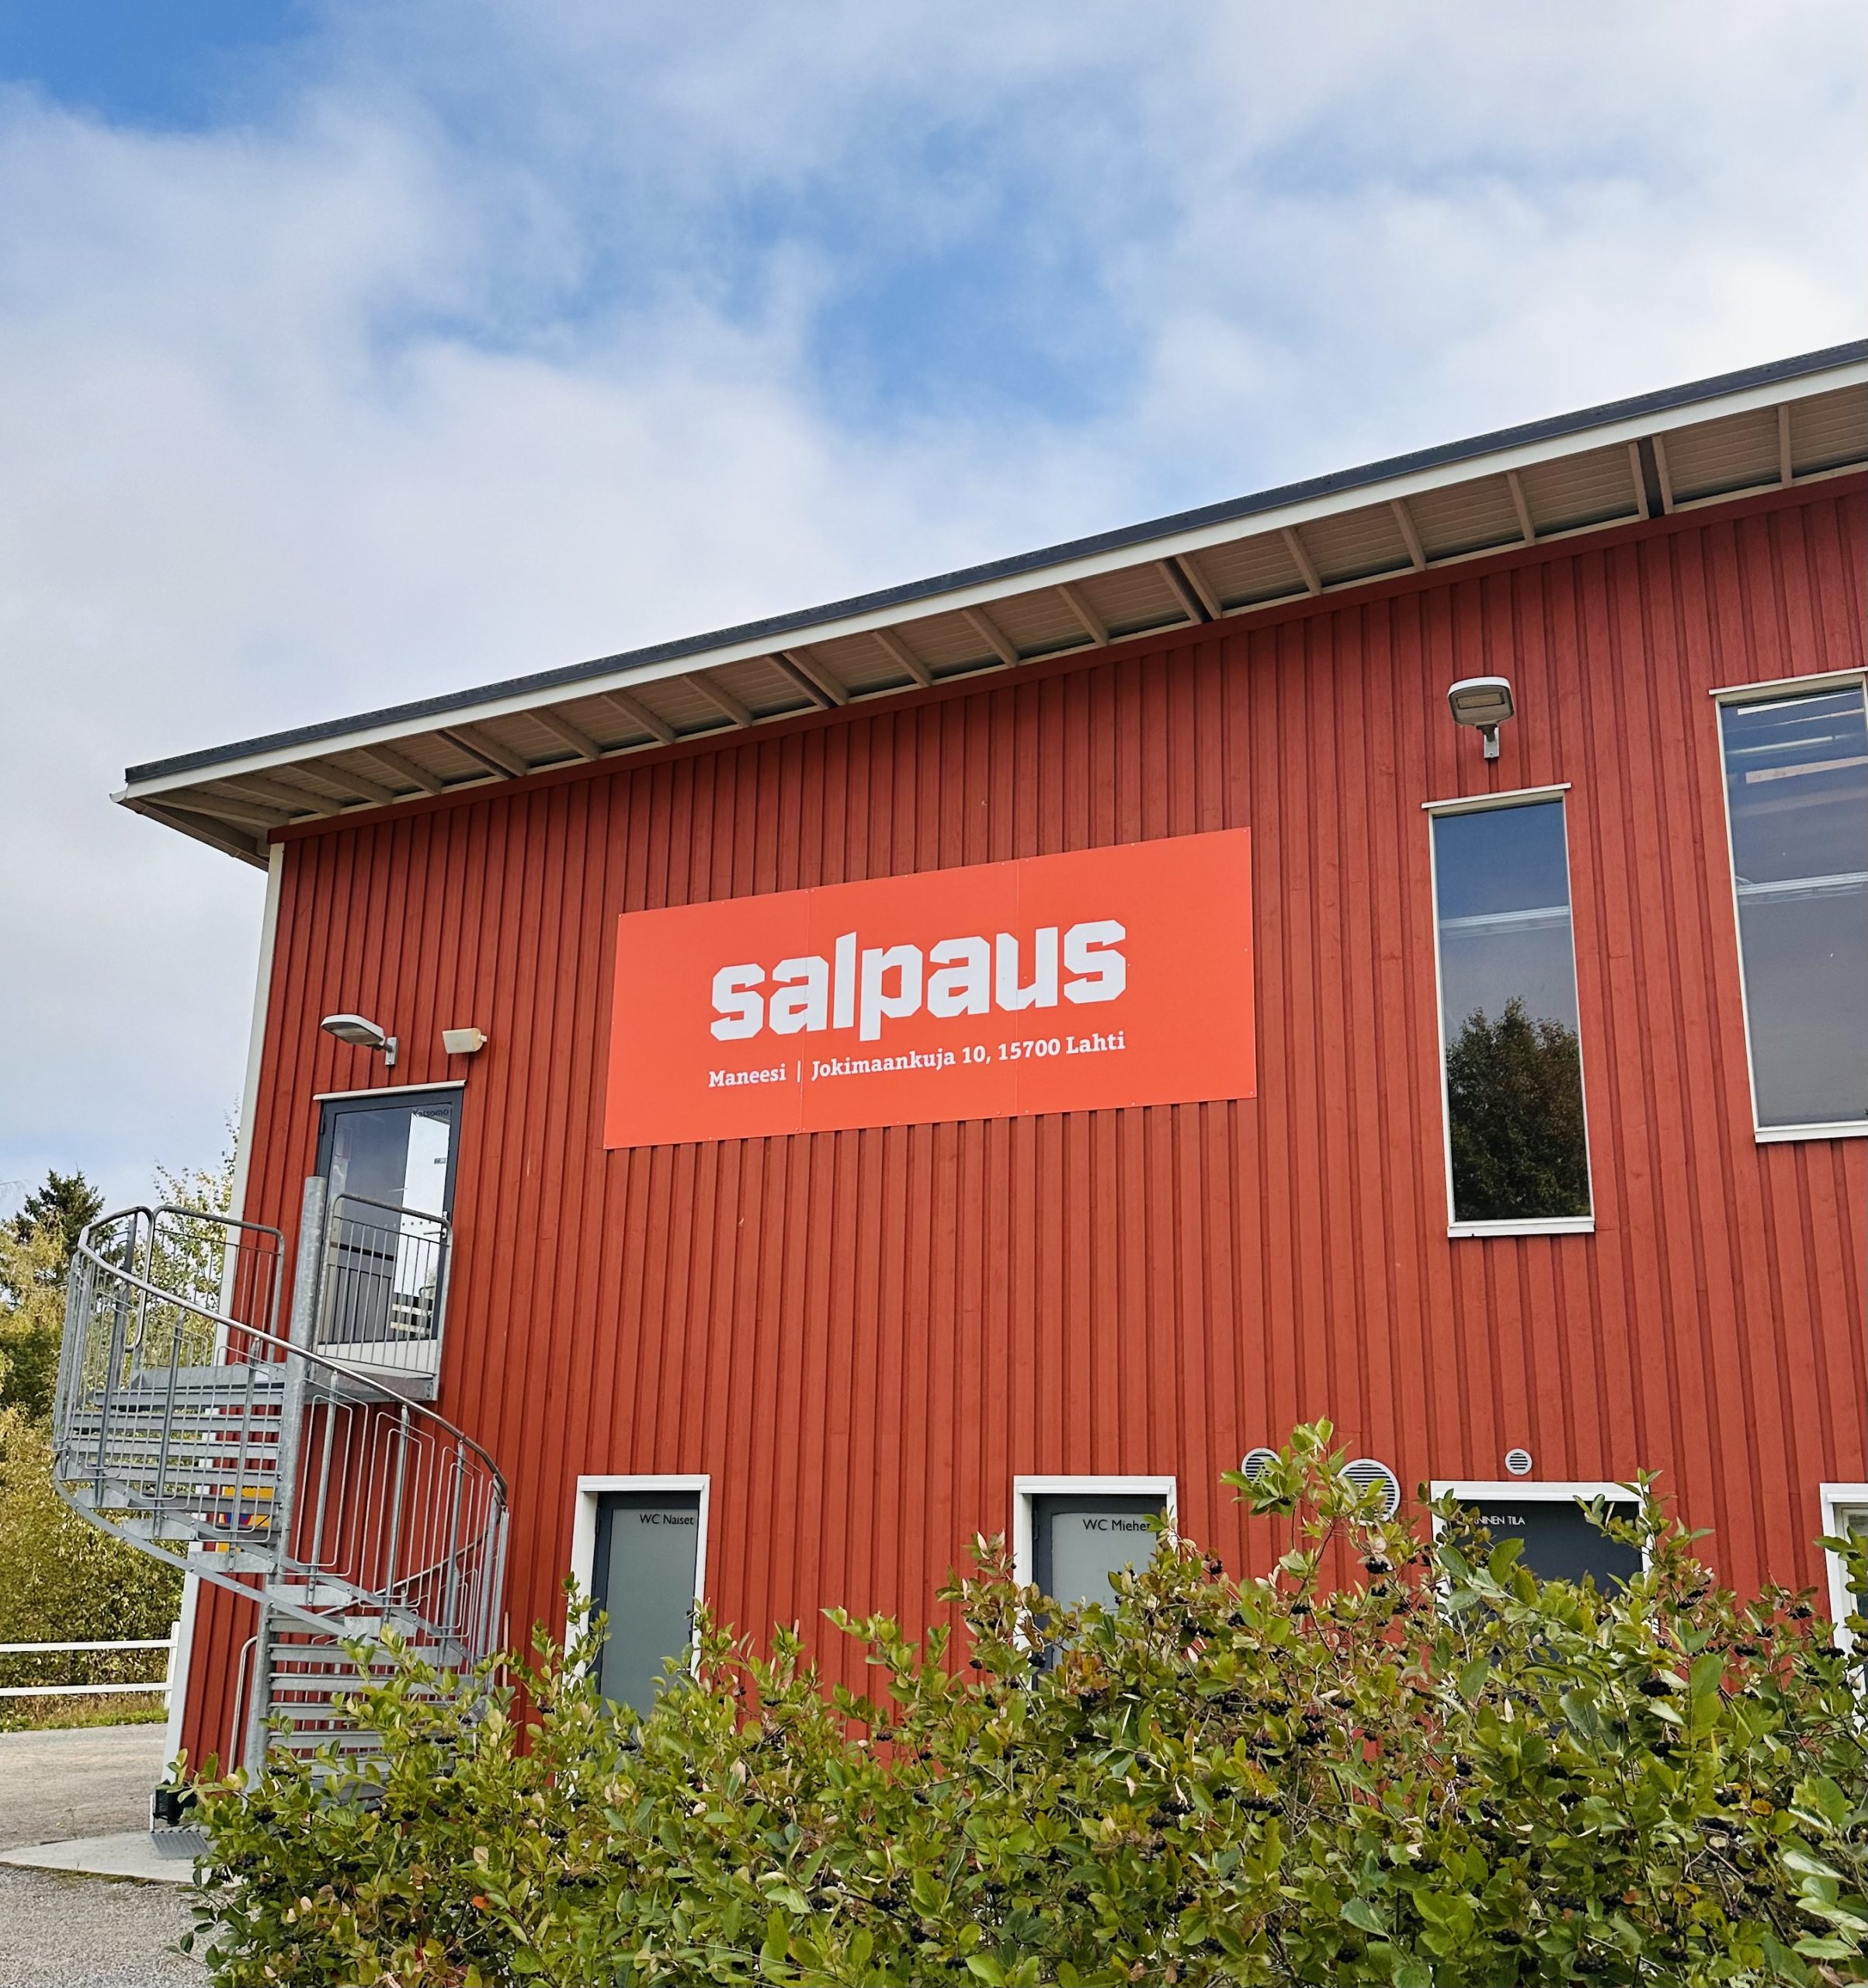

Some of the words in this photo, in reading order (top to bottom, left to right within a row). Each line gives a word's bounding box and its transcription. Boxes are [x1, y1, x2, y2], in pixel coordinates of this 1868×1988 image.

[710, 919, 1127, 1042] salpaus
[708, 1062, 786, 1088] Maneesi
[811, 1048, 957, 1082] Jokimaankuja
[962, 1045, 991, 1065] 10,
[998, 1038, 1061, 1061] 15700
[1065, 1030, 1126, 1055] Lahti
[640, 1514, 660, 1524] WC
[663, 1514, 694, 1524] Naiset
[1082, 1519, 1108, 1531] WC
[1507, 1515, 1526, 1525] TILA
